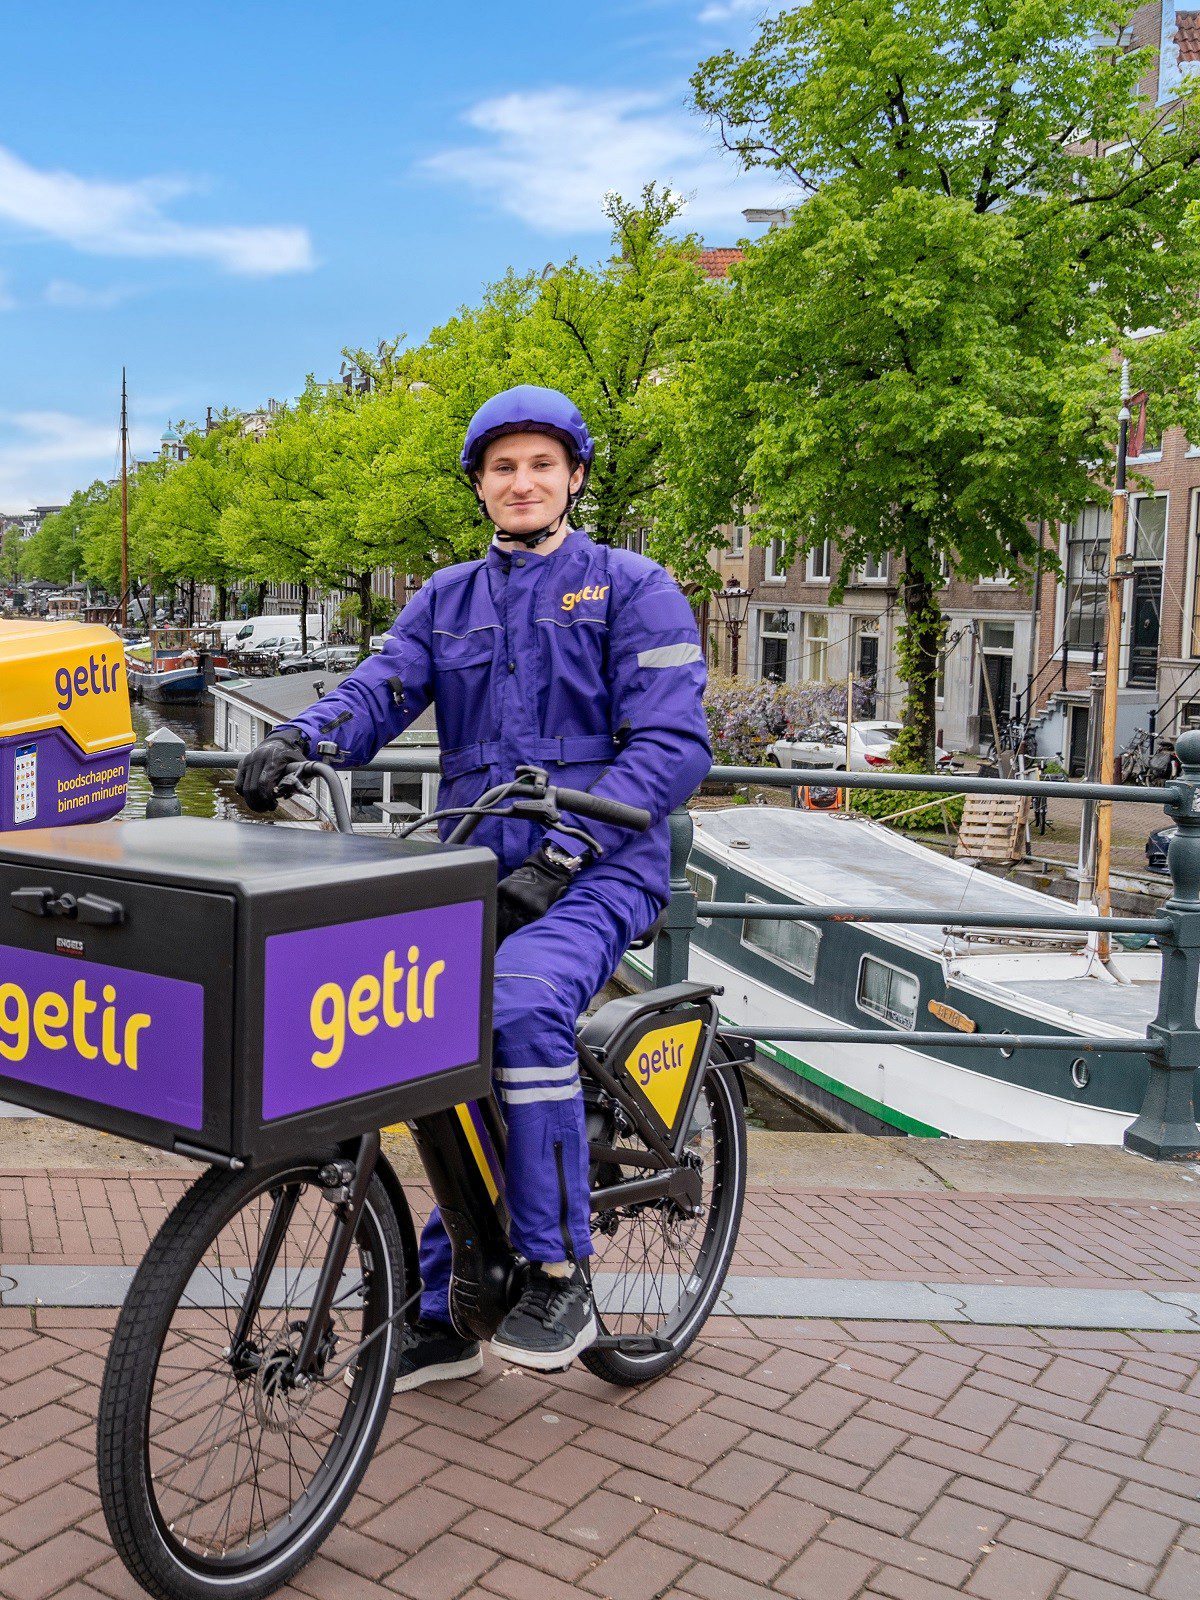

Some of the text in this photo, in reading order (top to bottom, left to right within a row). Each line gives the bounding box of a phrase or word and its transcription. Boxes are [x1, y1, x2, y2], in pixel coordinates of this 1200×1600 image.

[55, 653, 120, 711] getir
[57, 765, 124, 793] boodschappen
[57, 782, 128, 813] binnen minuten
[309, 945, 446, 1070] getir
[638, 1037, 684, 1086] getir
